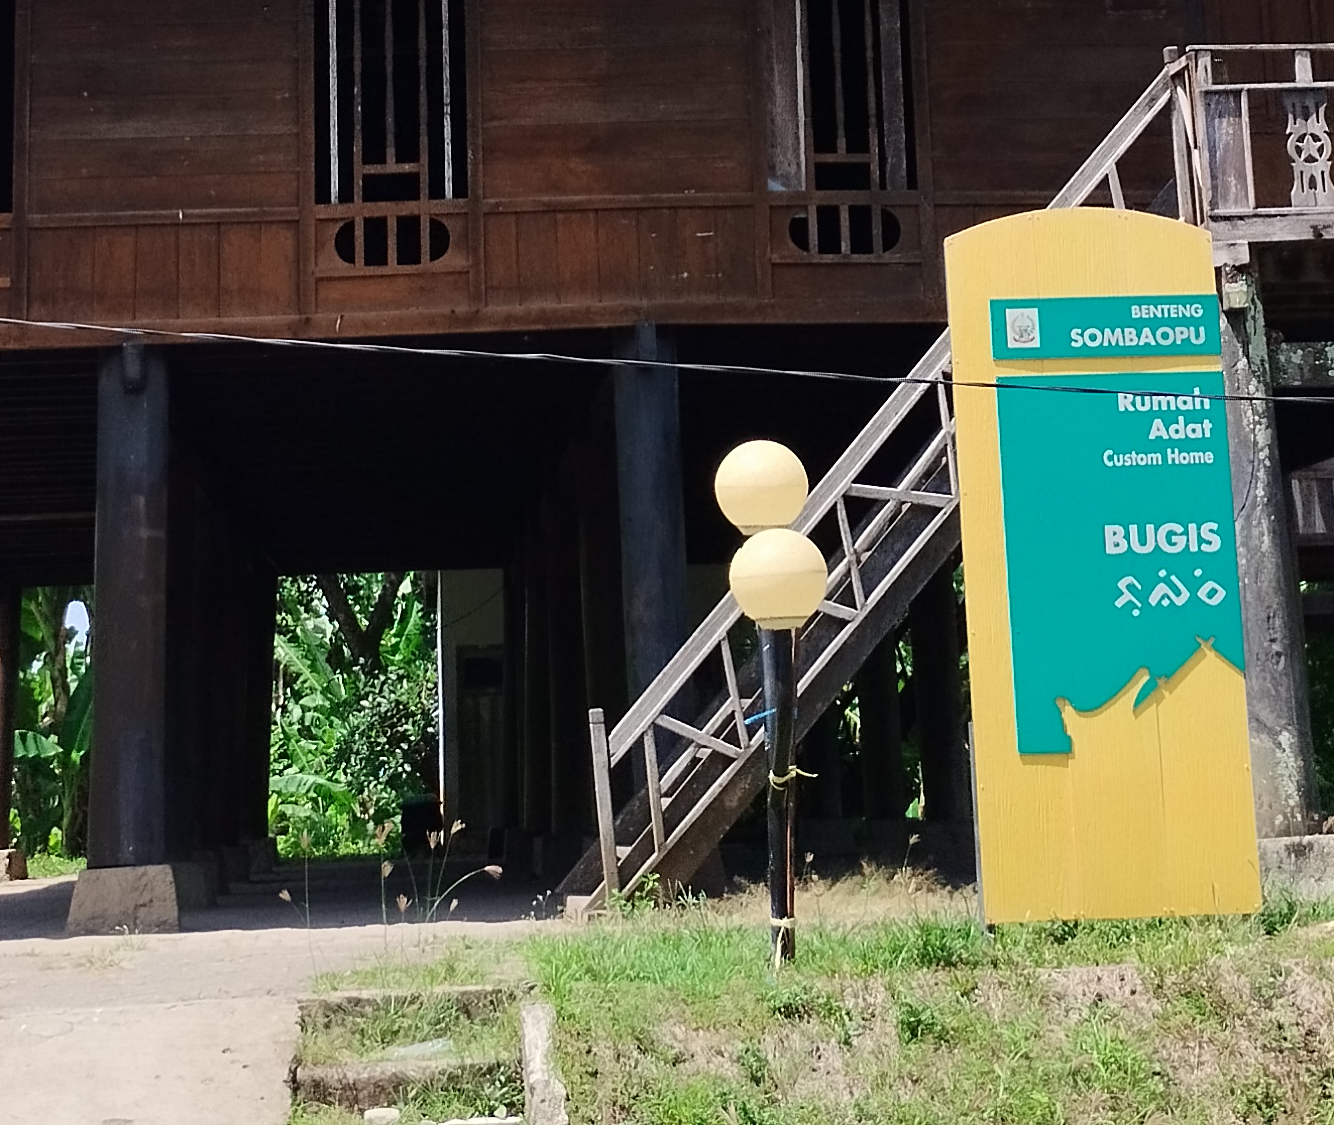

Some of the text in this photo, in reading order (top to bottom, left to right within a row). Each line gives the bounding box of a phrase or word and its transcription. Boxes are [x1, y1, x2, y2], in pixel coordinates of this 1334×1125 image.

[1131, 304, 1204, 319] BENTENG
[1070, 326, 1206, 347] SOMBAOPU
[1117, 387, 1211, 412] Rumah
[1148, 416, 1213, 440] Adat
[1103, 447, 1214, 467] Custom Home
[1104, 521, 1222, 555] BUGIS
